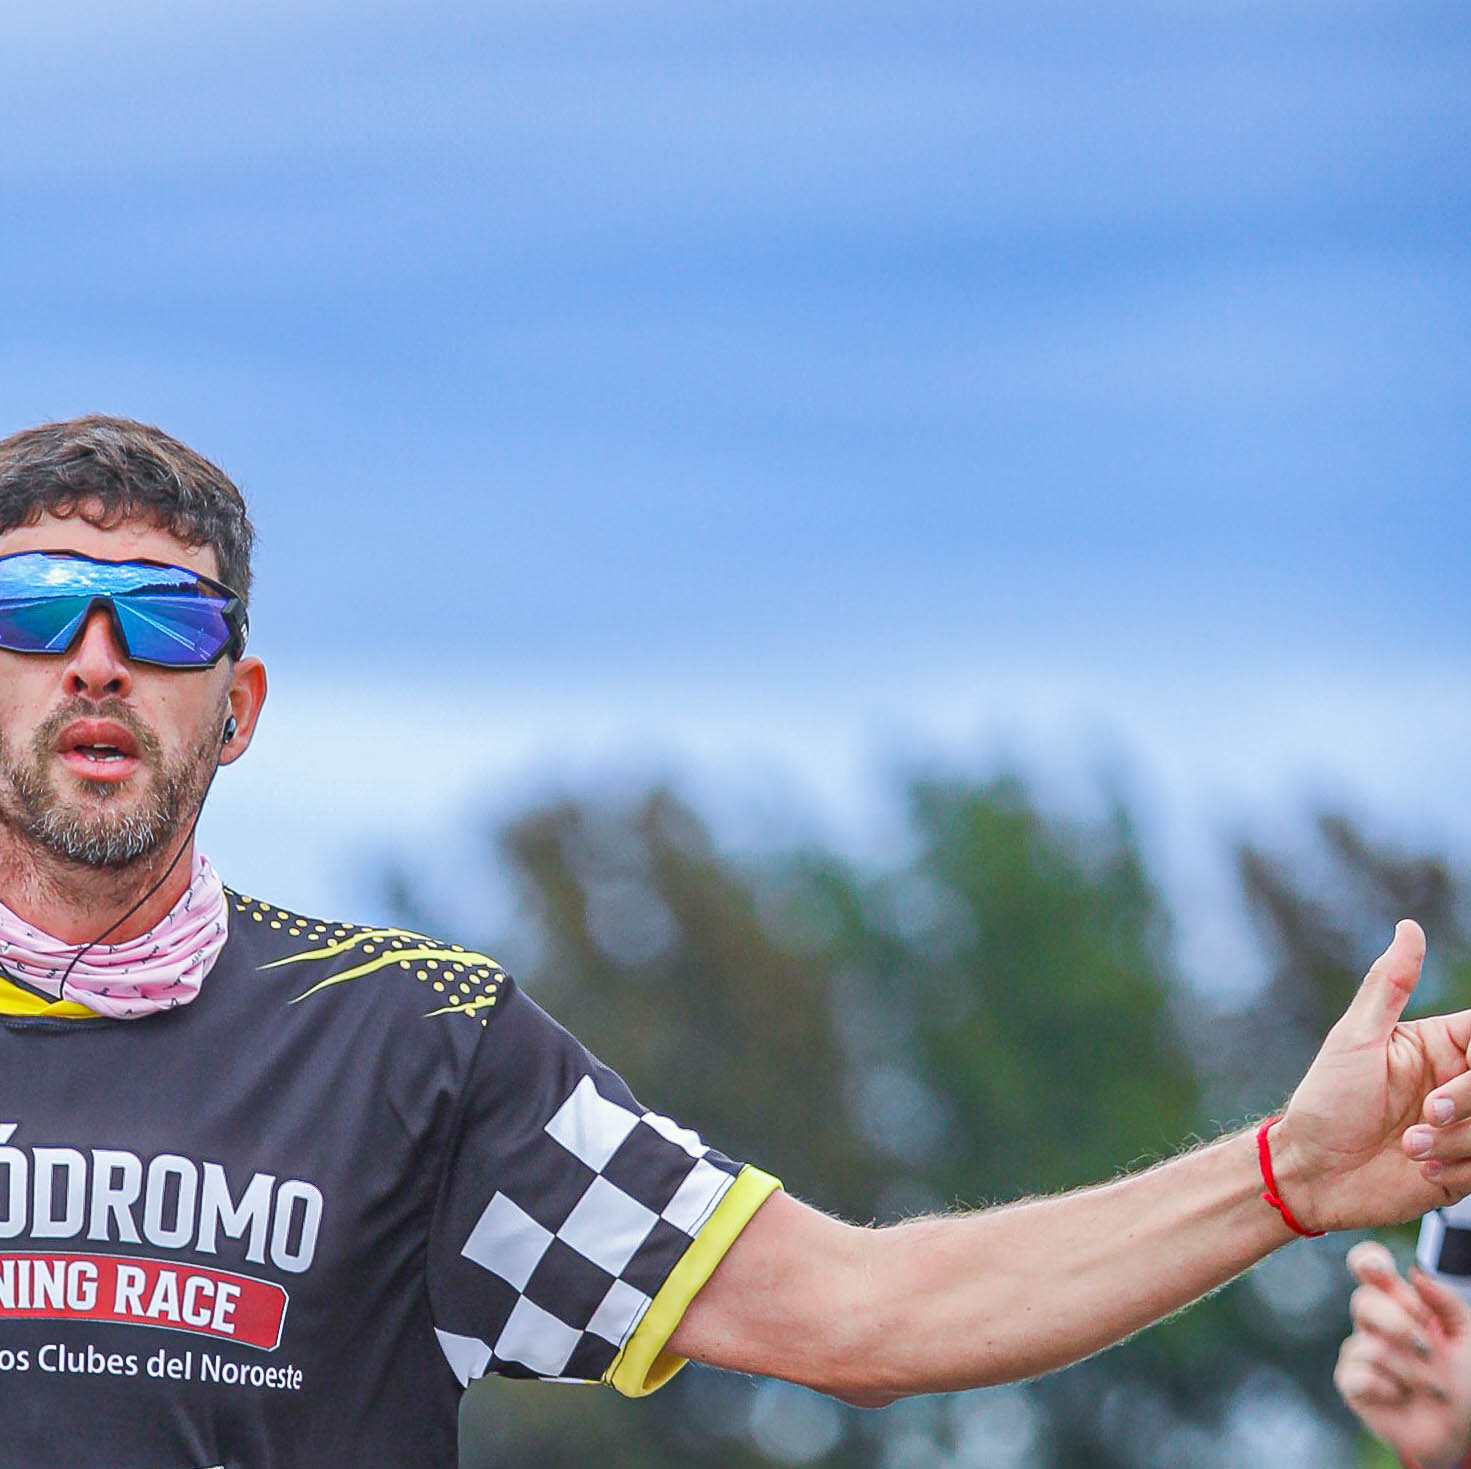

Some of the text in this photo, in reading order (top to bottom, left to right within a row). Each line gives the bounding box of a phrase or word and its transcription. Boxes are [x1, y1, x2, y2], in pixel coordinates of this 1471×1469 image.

[114, 1263, 242, 1334] RACE
[38, 1344, 139, 1376] Clubes
[146, 1349, 192, 1380] del
[200, 1354, 303, 1390] Noroeste
